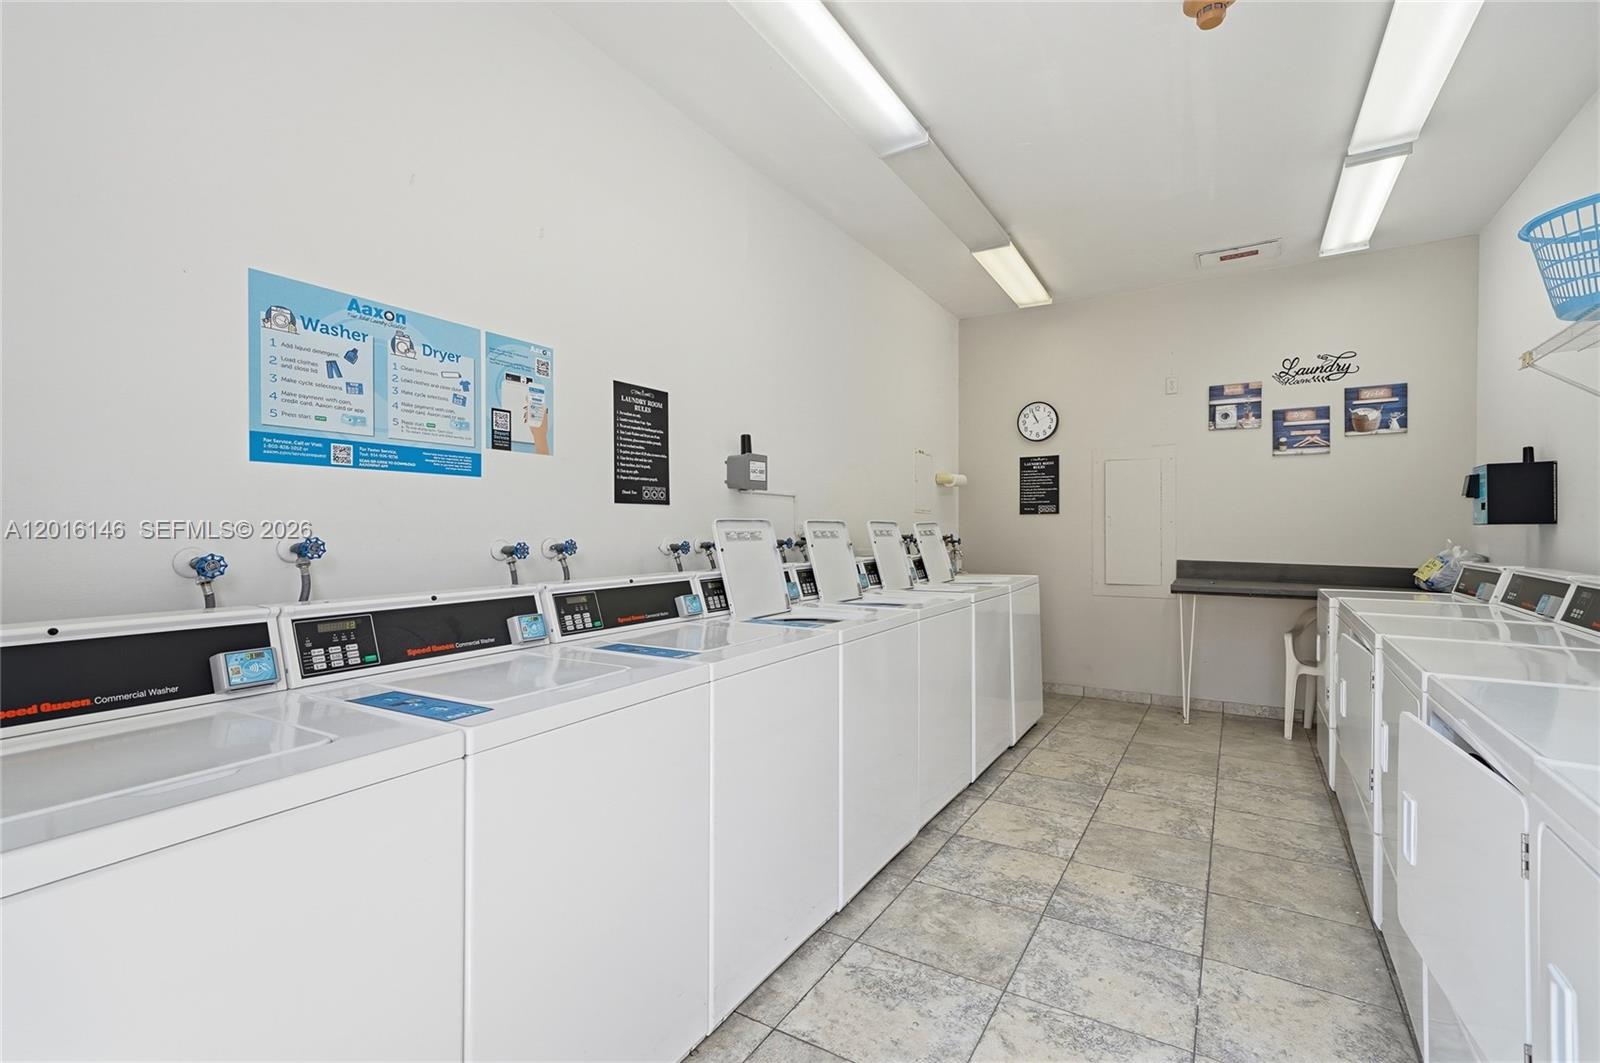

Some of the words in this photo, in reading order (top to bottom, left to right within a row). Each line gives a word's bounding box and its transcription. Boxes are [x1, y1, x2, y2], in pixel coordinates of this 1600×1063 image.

[347, 298, 406, 325] Aaxon
[300, 315, 369, 343] Washer
[269, 338, 277, 347] 1
[294, 344, 311, 353] liquid
[422, 343, 461, 363] Dryer
[269, 355, 278, 365] 2
[297, 358, 318, 367] clothes
[1278, 351, 1360, 382] Laundry
[294, 365, 309, 373] close
[269, 374, 278, 383] 3
[298, 380, 313, 388] cycle
[392, 374, 399, 383] 2
[1284, 376, 1313, 386] Room
[269, 391, 278, 400] 4
[298, 393, 324, 402] payment
[392, 386, 399, 395] 3
[621, 394, 646, 405] LAUNDRY
[648, 400, 663, 409] ROOM
[269, 408, 278, 417] 5
[281, 410, 297, 418] Press
[634, 404, 651, 414] RULES
[392, 418, 399, 426] 5
[406, 645, 431, 657] Speed
[432, 643, 455, 652] Queen
[455, 640, 480, 648] Commercial
[40, 700, 92, 713] Queen
[94, 690, 147, 704] Commercial
[148, 685, 179, 697] Washer
